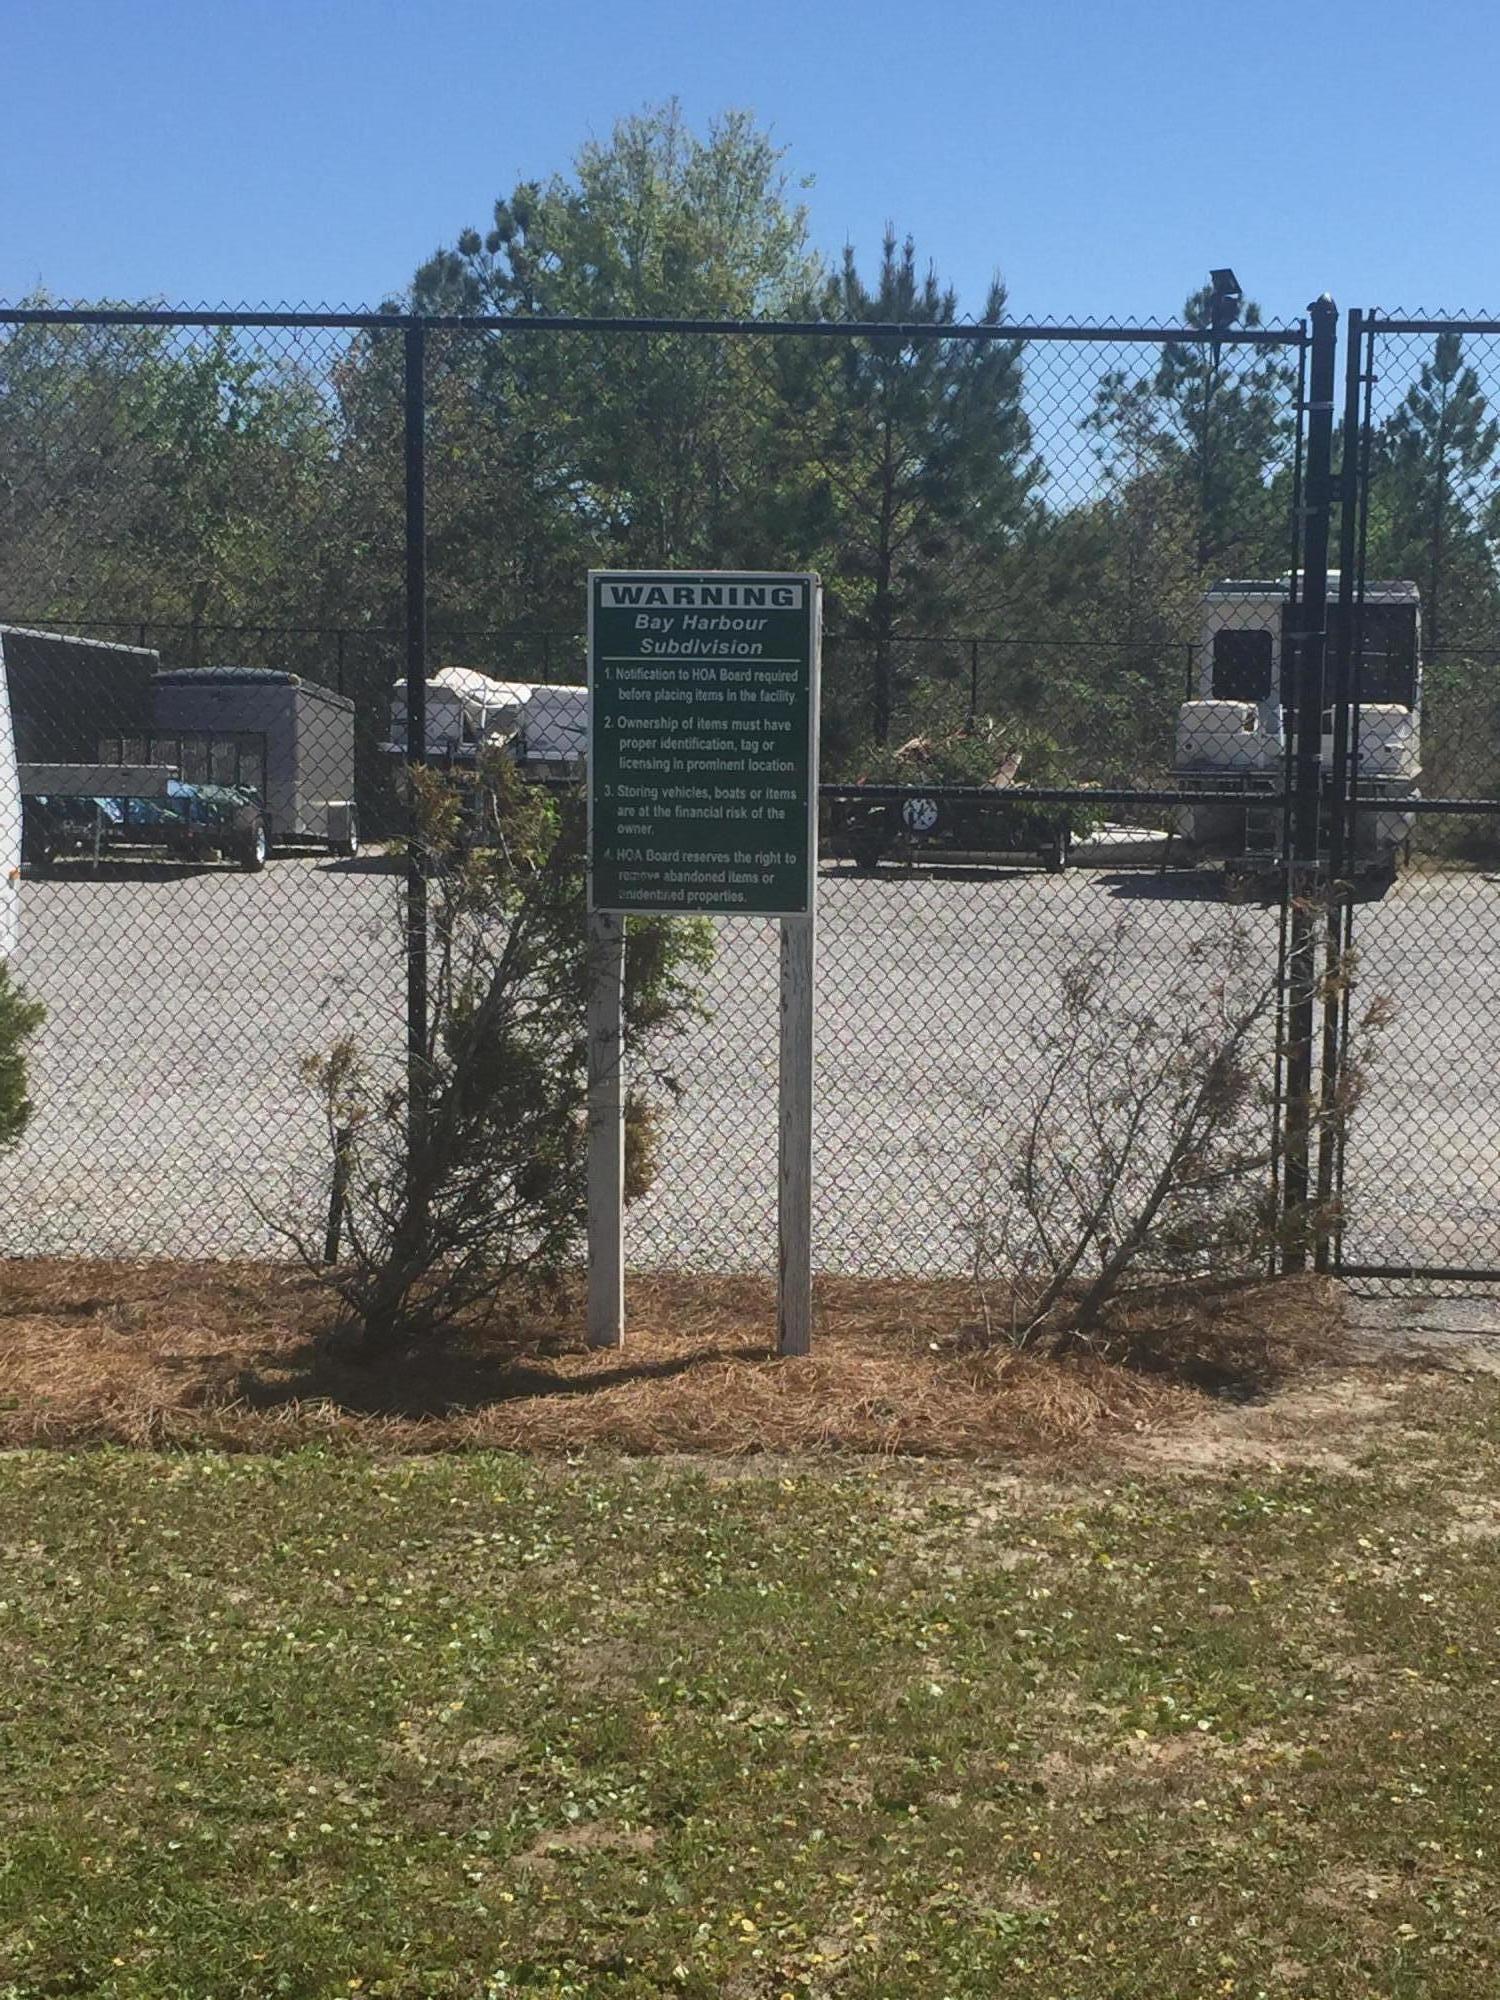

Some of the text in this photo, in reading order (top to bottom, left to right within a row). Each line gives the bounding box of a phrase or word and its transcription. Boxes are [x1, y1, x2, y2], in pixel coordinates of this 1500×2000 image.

[610, 586, 793, 606] WARNING
[635, 614, 768, 632] Bay Harbour
[640, 638, 762, 655] Subdivision
[616, 669, 675, 680] Notification
[679, 670, 688, 680] to
[692, 670, 716, 680] HOA
[720, 669, 751, 681] Board
[754, 670, 798, 683] required
[619, 688, 651, 700] before
[654, 690, 693, 704] placing
[696, 689, 724, 700] items
[727, 689, 737, 700] in
[740, 689, 756, 701] the
[617, 716, 678, 731] Ownership
[682, 717, 694, 729] of
[697, 718, 728, 729] items
[732, 719, 760, 730] must
[764, 719, 791, 730] have
[619, 737, 775, 753] proper identification, tag or
[619, 757, 670, 772] licensing
[674, 757, 683, 769] in
[687, 758, 744, 772] prominent
[617, 785, 658, 799] Storing
[662, 787, 712, 800] vehicles,
[715, 788, 746, 799] boats
[750, 789, 763, 799] or
[766, 788, 796, 800] items
[617, 806, 785, 819] are at the financial risk of the
[617, 849, 642, 861] HOA
[646, 850, 679, 862] Board
[682, 853, 729, 863] reserves
[734, 852, 750, 863] the
[755, 852, 781, 867] right
[785, 853, 796, 864] to
[664, 870, 725, 882] abandoned
[728, 871, 758, 883] items
[762, 873, 775, 883] or
